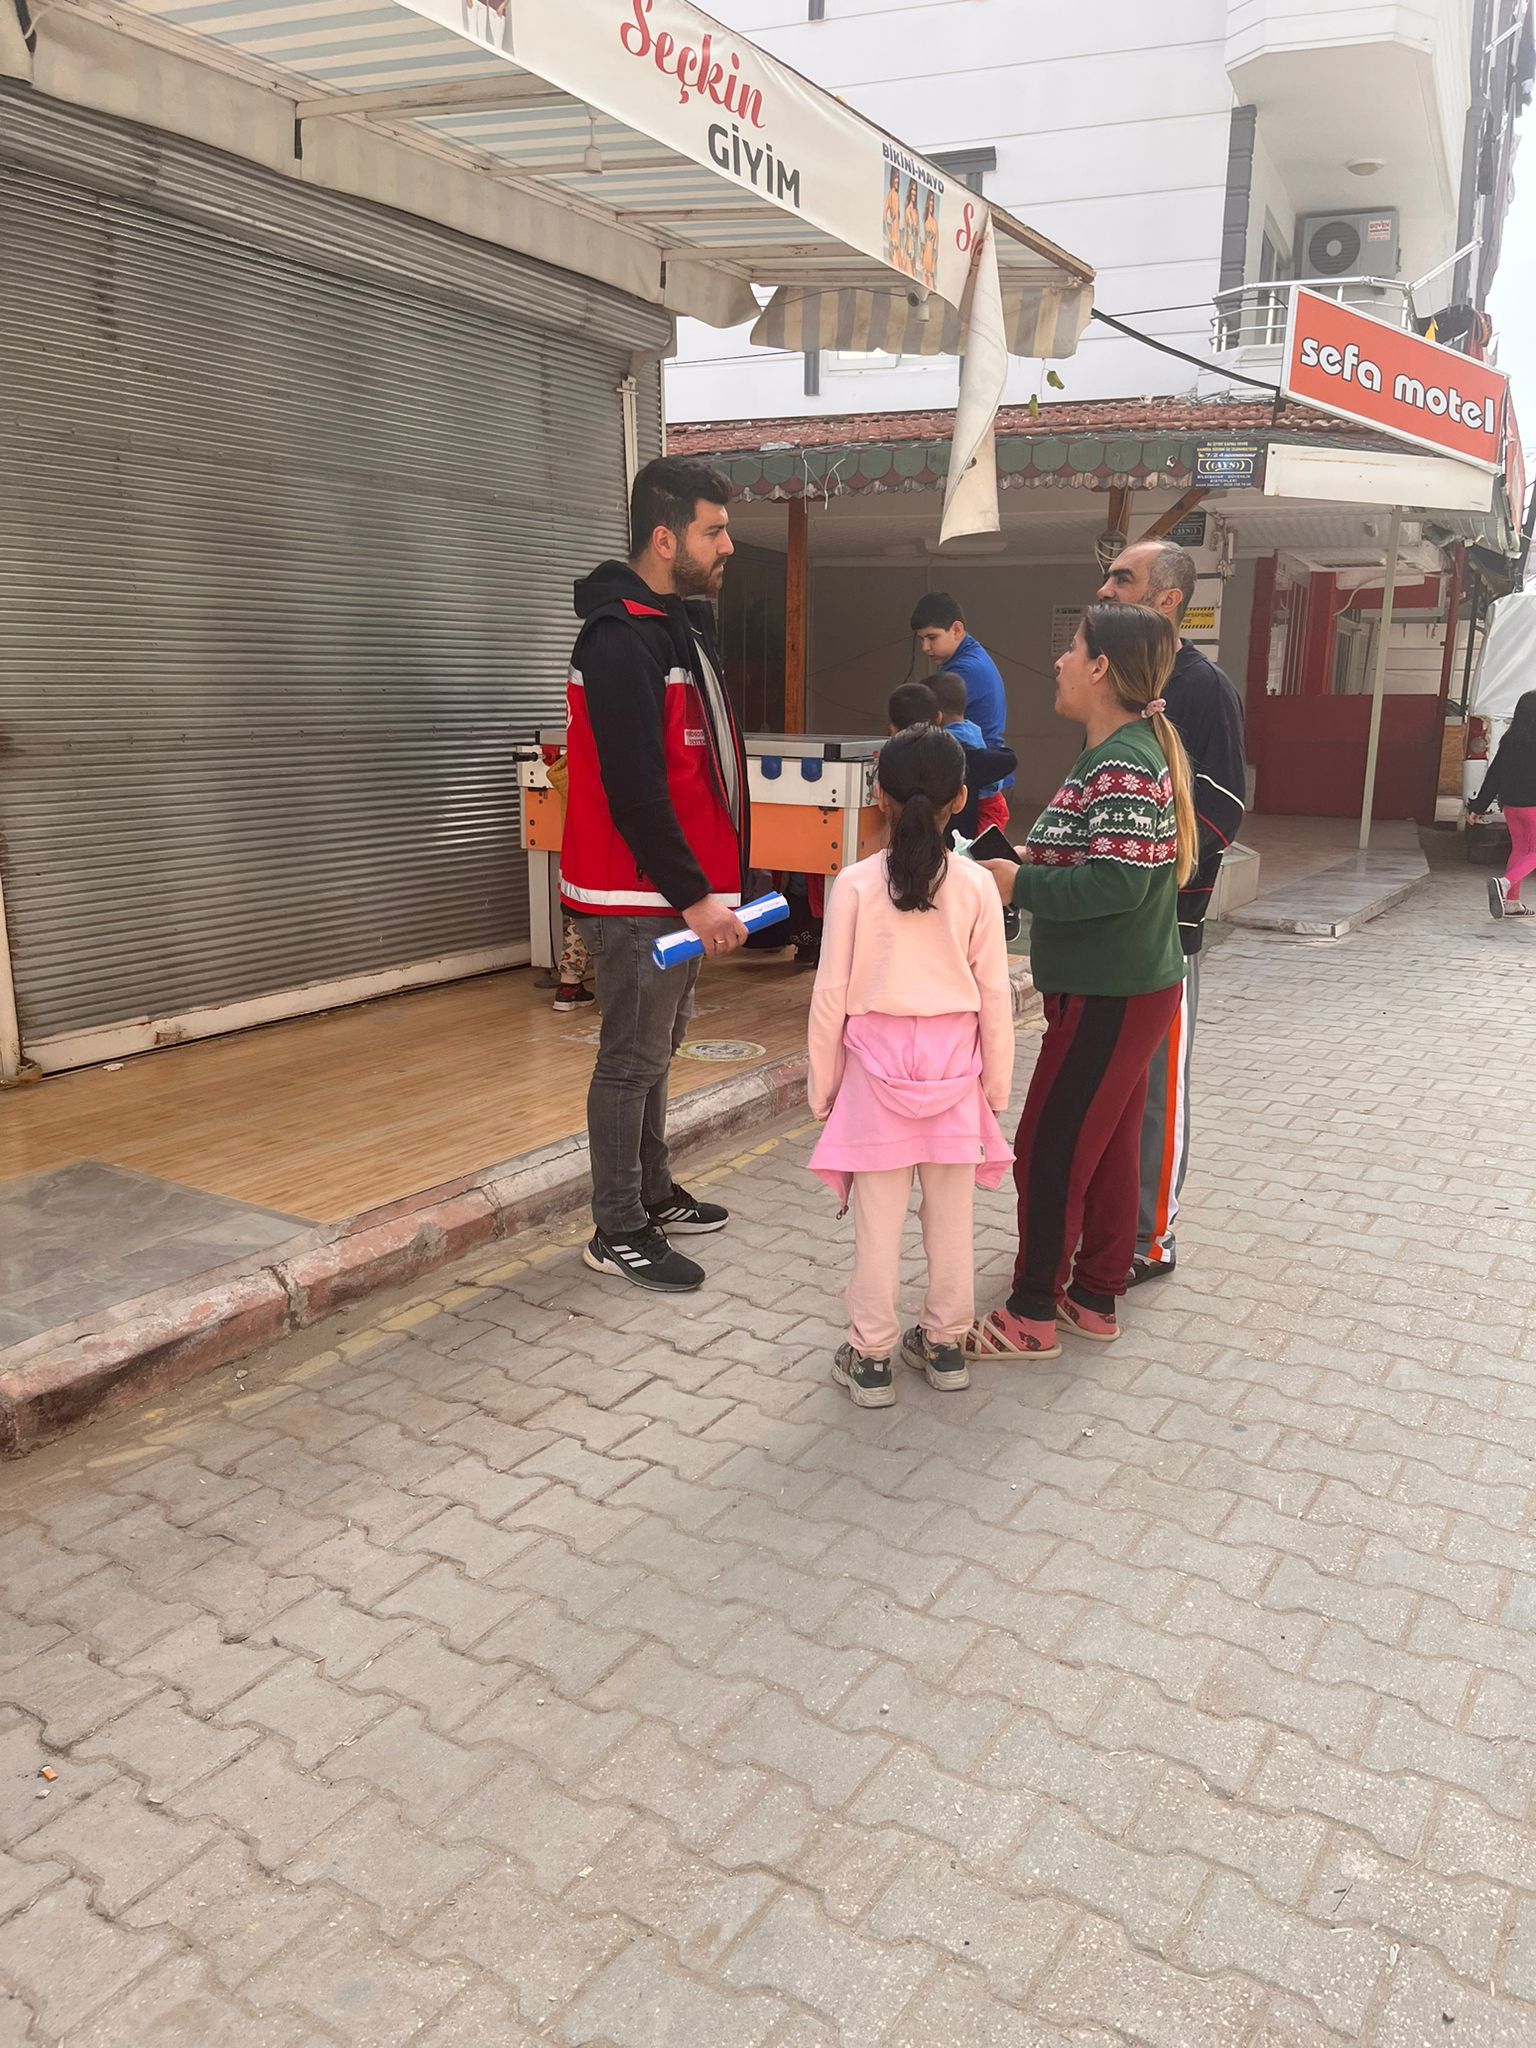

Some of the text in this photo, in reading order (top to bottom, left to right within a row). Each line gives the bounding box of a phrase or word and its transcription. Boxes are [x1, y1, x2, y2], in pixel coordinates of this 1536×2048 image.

[620, 0, 766, 128] Seçkin
[708, 123, 801, 209] GİYİM
[882, 142, 945, 194] BİKİNİ-MAYO
[1300, 336, 1496, 435] sefa motel
